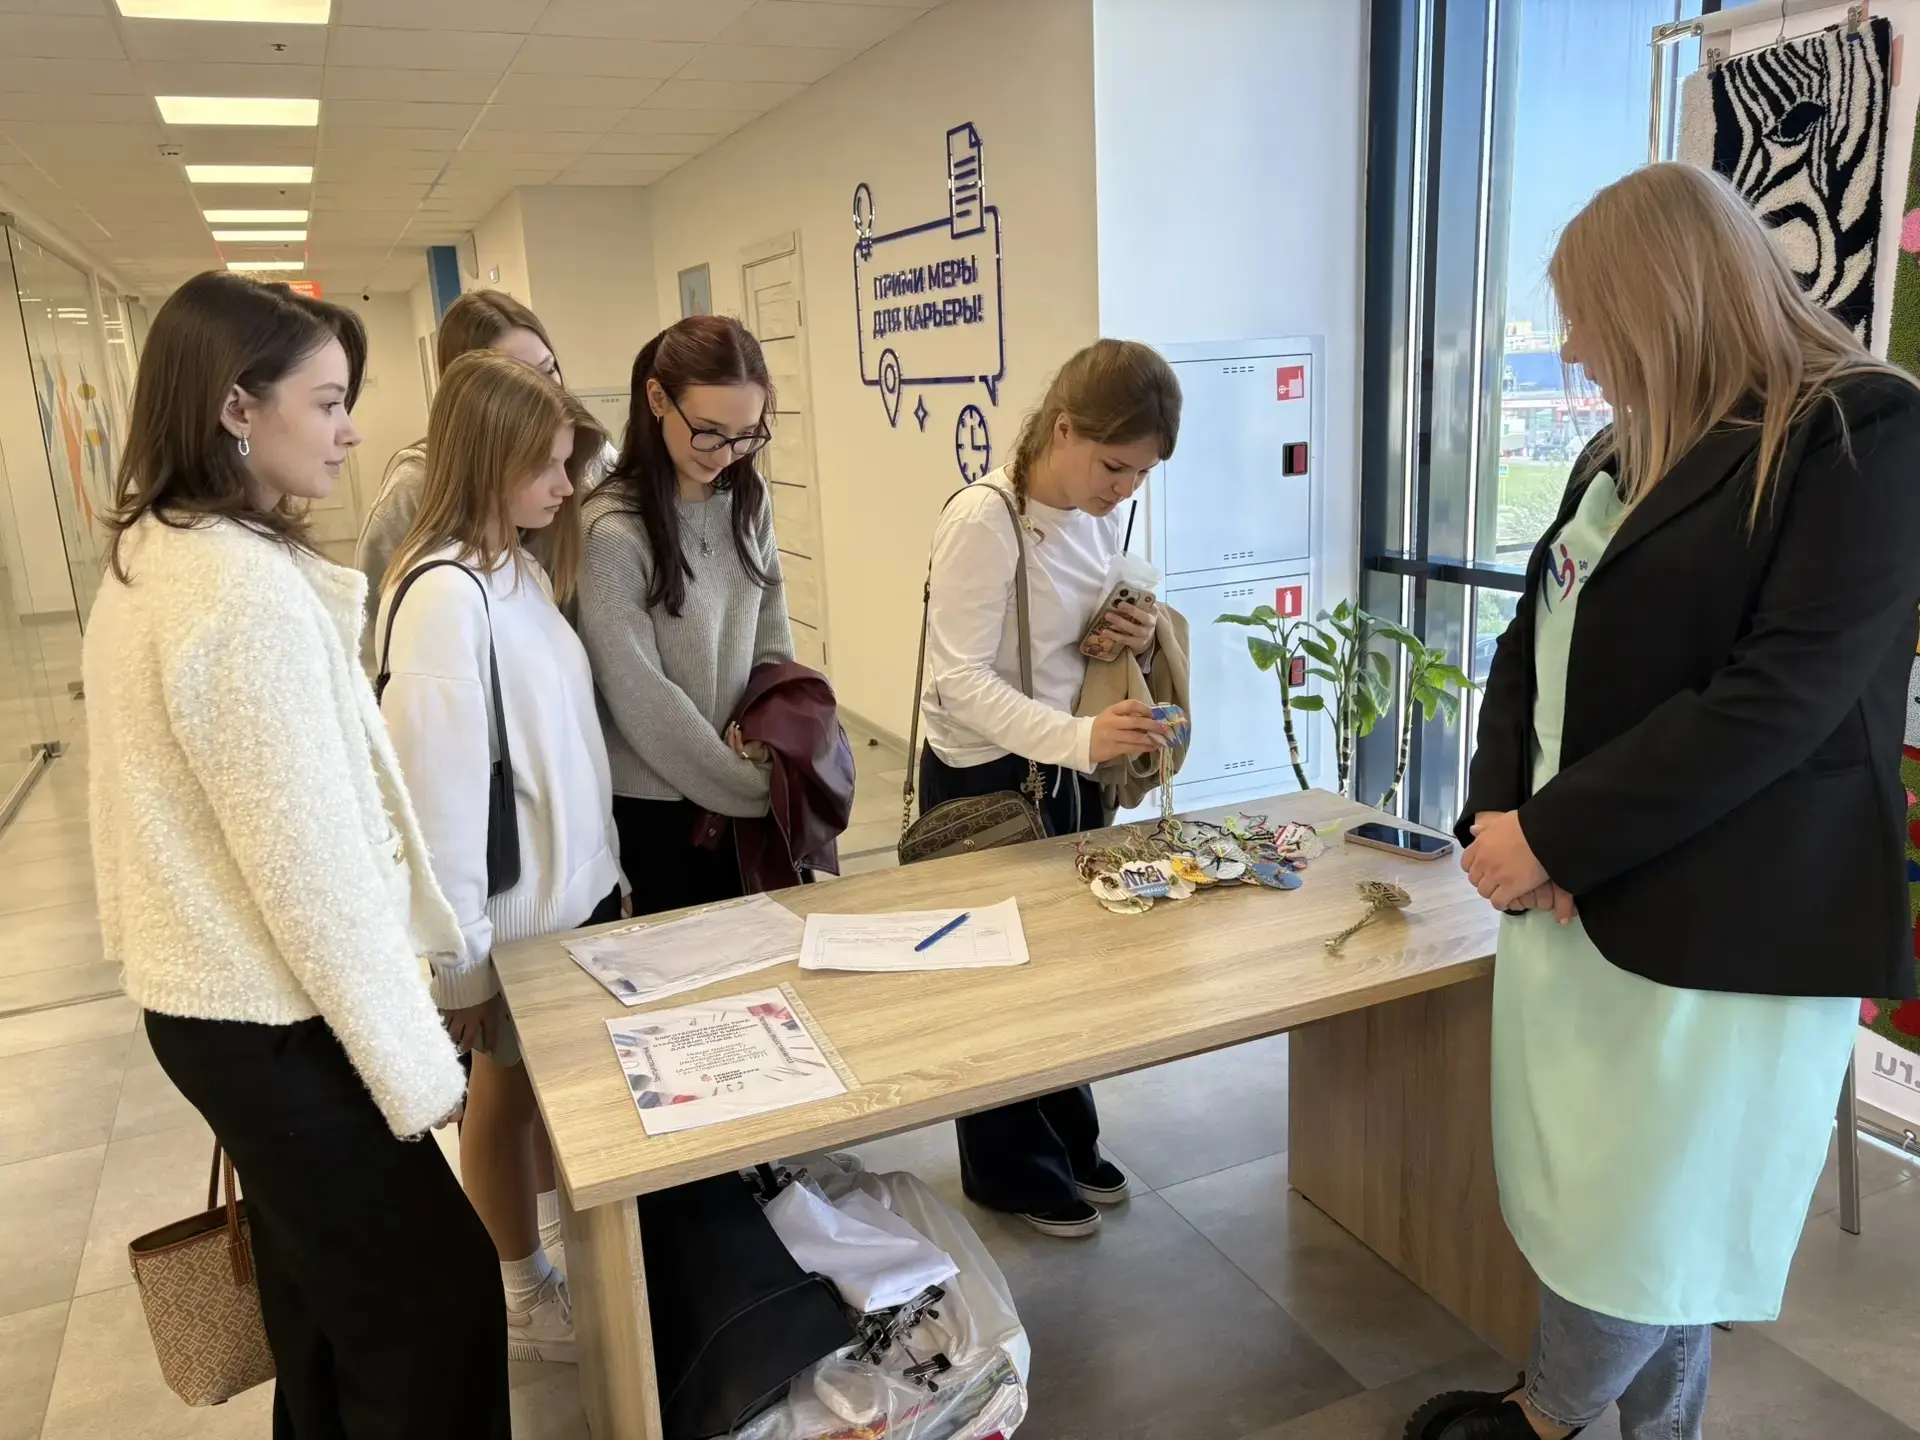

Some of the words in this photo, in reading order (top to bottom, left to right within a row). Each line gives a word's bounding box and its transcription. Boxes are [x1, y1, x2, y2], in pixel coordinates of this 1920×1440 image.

[873, 267, 925, 300] ПРИМИ
[928, 254, 978, 291] МЕРЫ
[873, 308, 902, 340] ДЛЯ
[904, 294, 984, 332] КАРЬЕРЫ!
